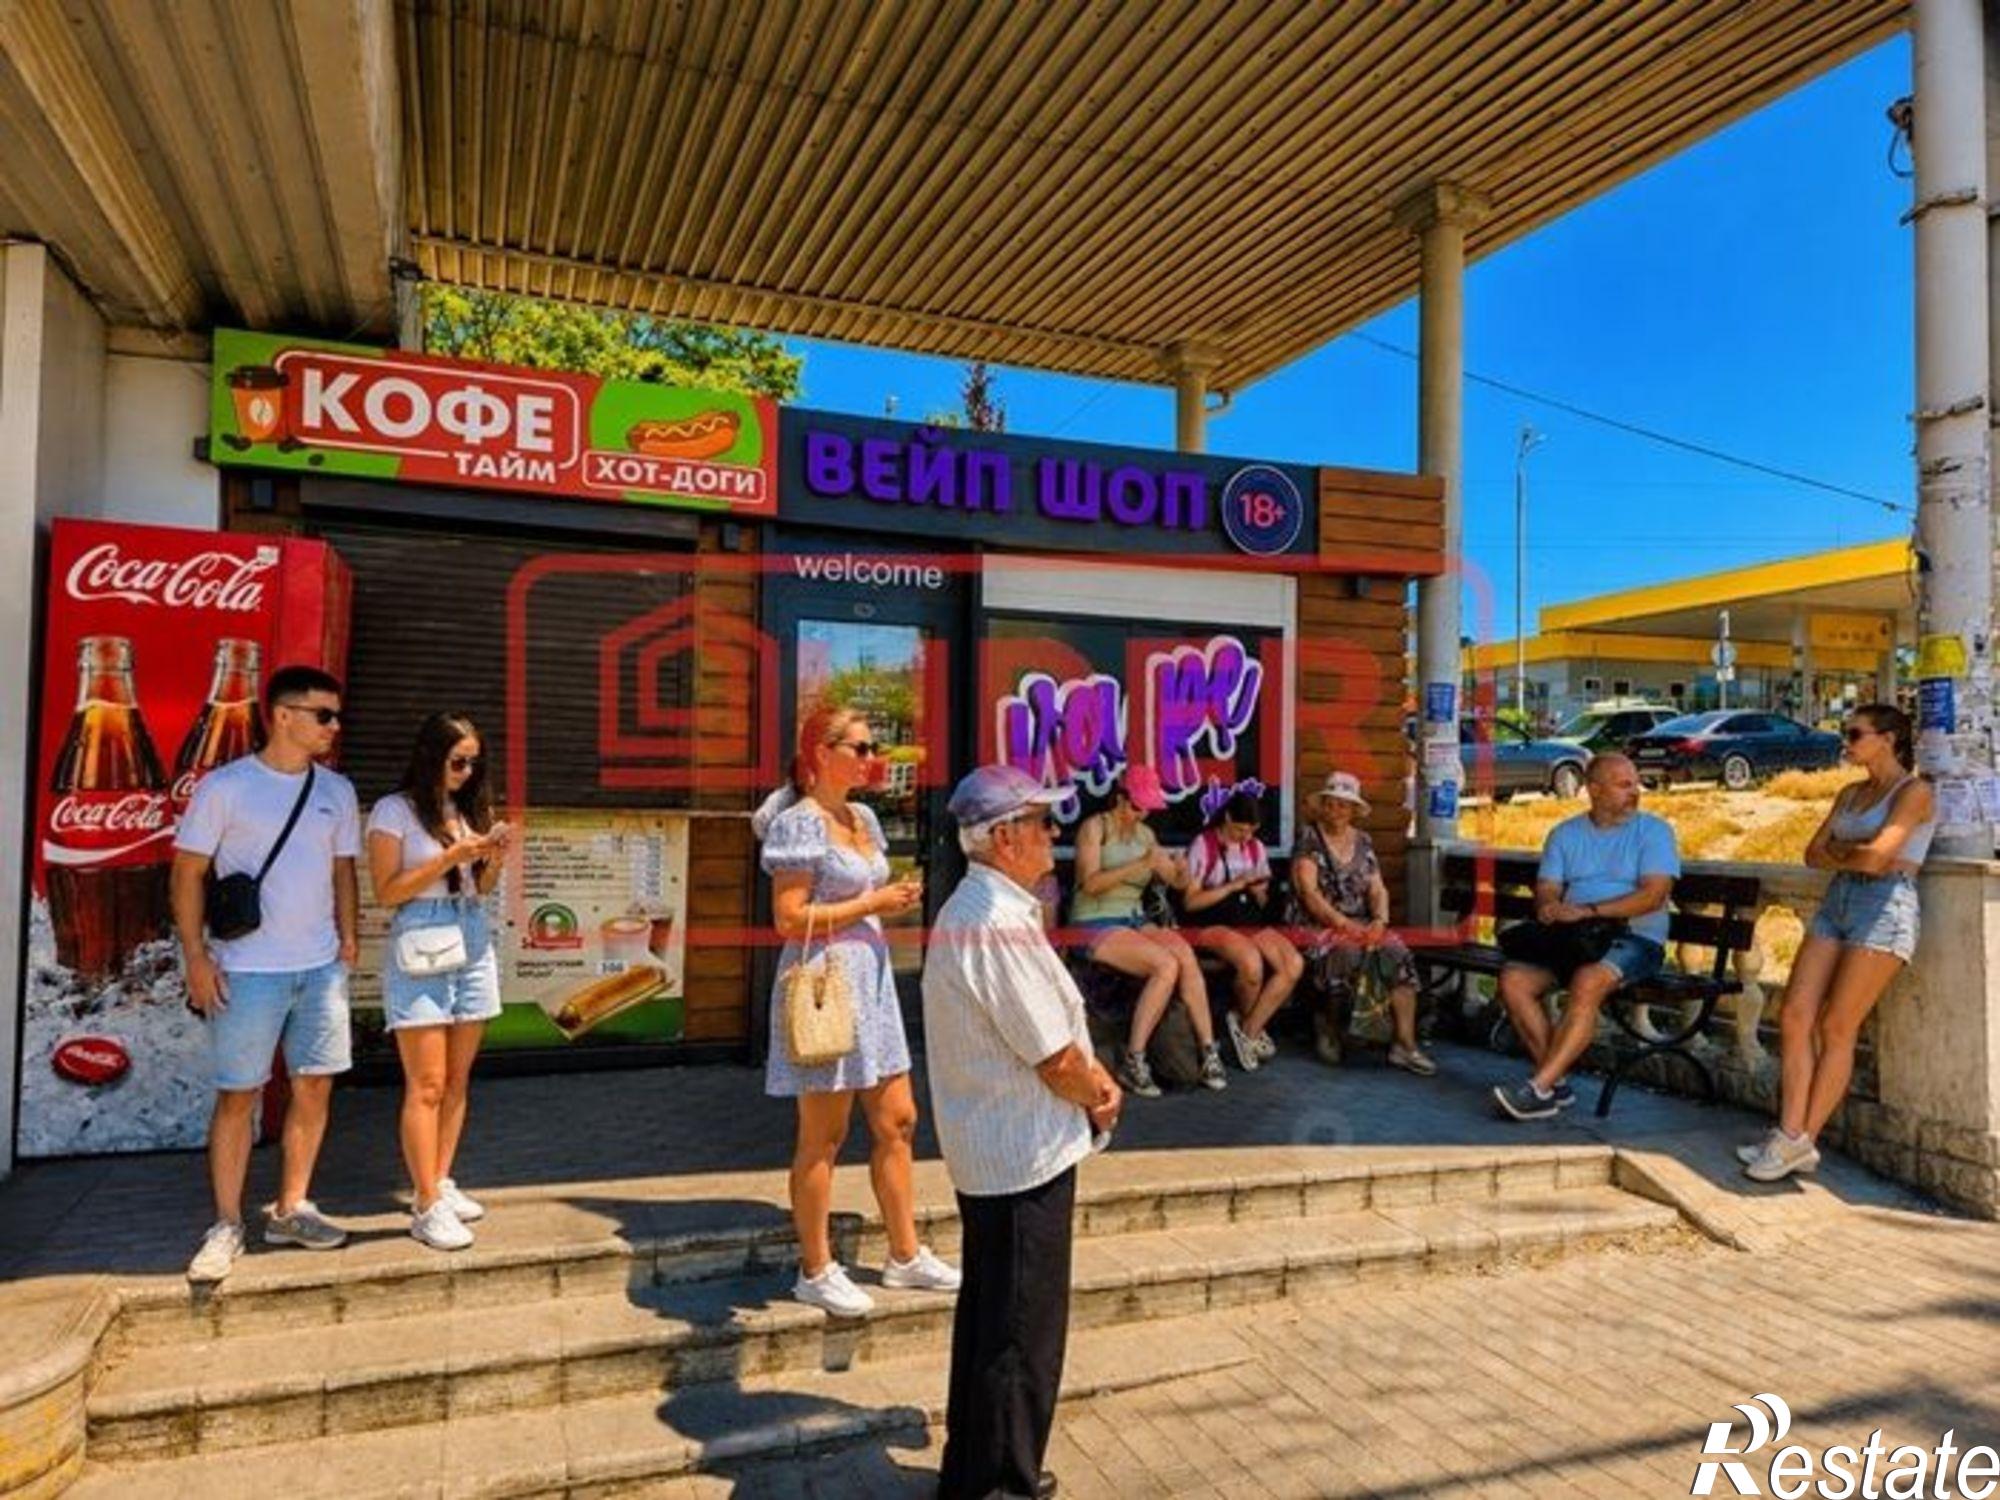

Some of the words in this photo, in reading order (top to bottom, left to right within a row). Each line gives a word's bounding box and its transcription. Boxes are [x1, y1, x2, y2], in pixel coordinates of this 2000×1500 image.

[302, 368, 553, 451] КОФЕ
[454, 451, 555, 483] ТАЙМ
[596, 456, 757, 495] ХОТ-ДОГИ
[806, 427, 1013, 510] ВЕЙП
[1039, 457, 1207, 529] ШОП
[1239, 492, 1287, 528] 18+
[794, 553, 943, 588] welcome
